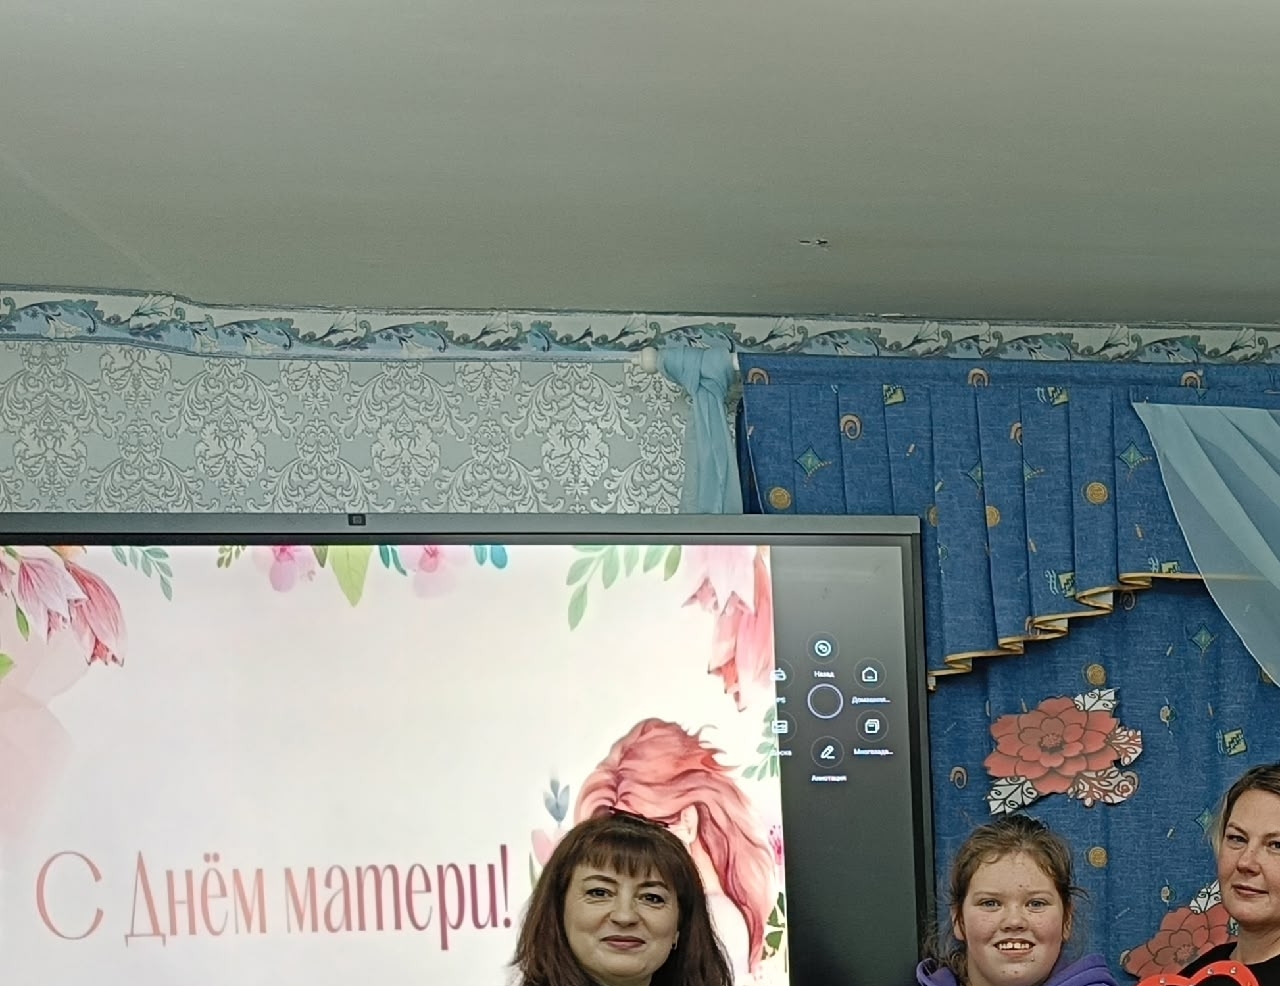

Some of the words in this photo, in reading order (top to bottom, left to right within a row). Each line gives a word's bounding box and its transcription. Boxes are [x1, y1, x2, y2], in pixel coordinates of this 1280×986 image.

[35, 850, 104, 941] С
[124, 849, 268, 947] Днём
[283, 843, 513, 951] матери!
